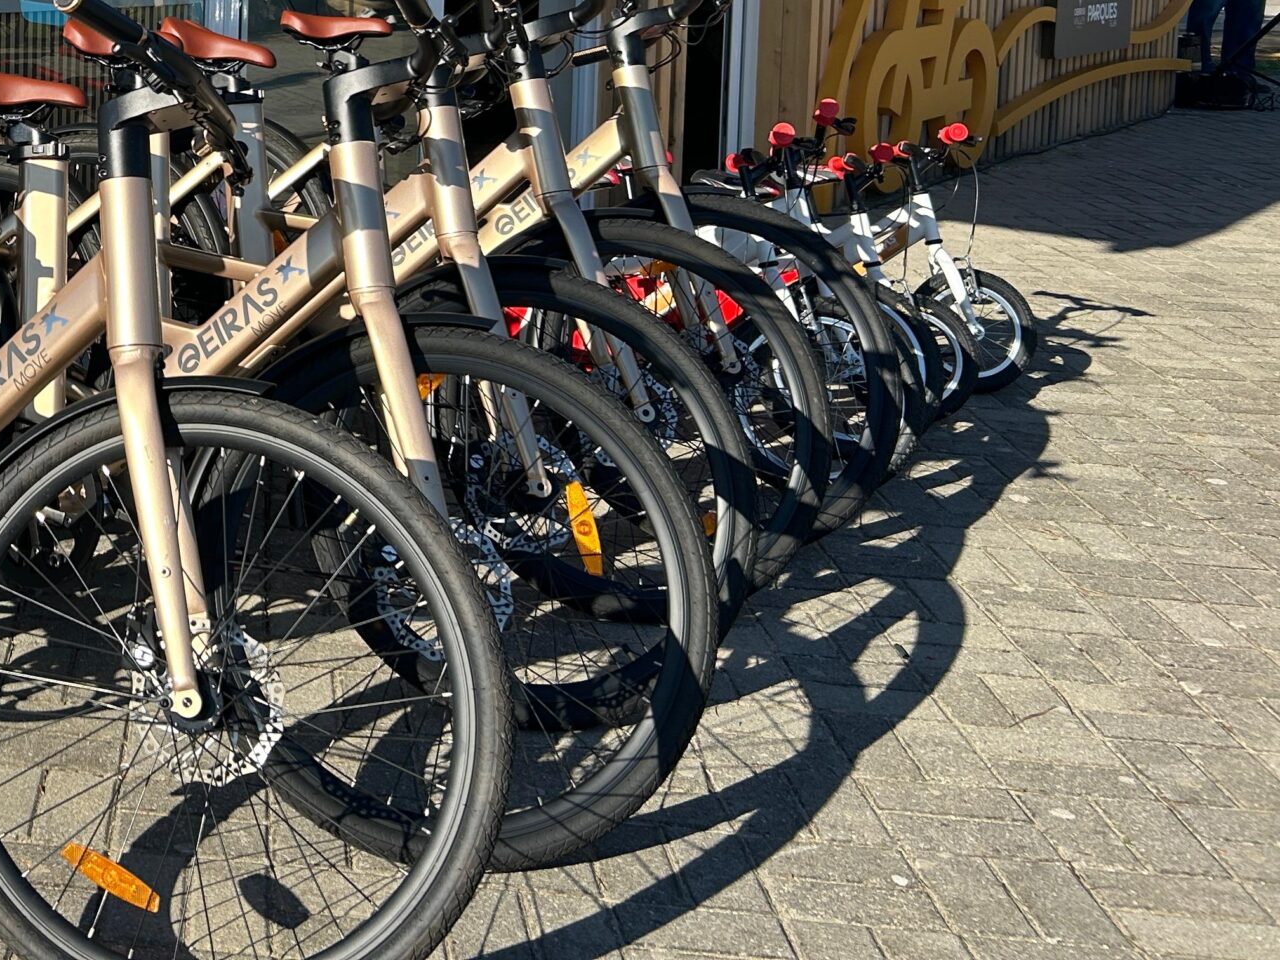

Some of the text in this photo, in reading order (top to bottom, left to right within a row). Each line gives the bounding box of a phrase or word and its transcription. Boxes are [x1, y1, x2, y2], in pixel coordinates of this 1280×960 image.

[1087, 2, 1118, 24] PARQUES
[250, 301, 288, 338] MOVE
[13, 348, 52, 391] MOVE
